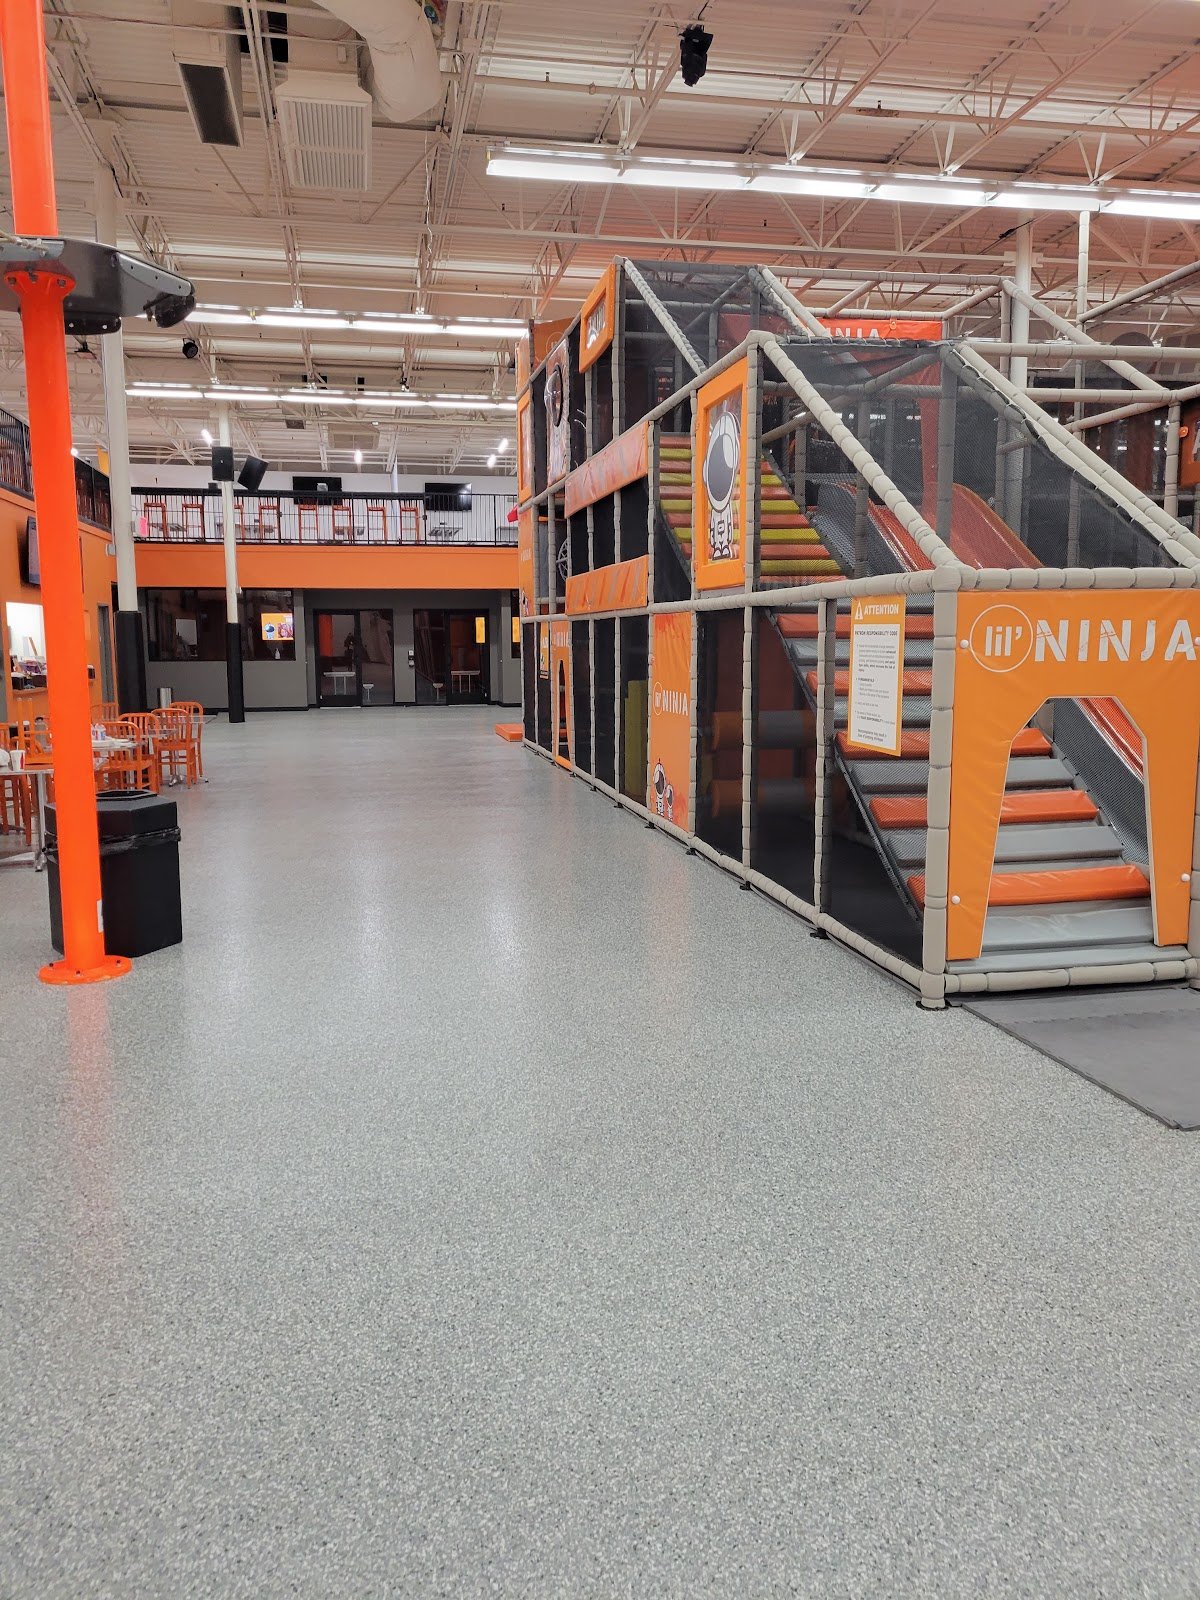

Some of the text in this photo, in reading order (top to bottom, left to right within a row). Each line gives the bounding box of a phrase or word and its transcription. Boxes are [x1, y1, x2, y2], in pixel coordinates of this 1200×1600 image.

[863, 603, 899, 615] ATTENTION
[984, 619, 1197, 662] lil' NINJA
[662, 689, 689, 717] NINJA
